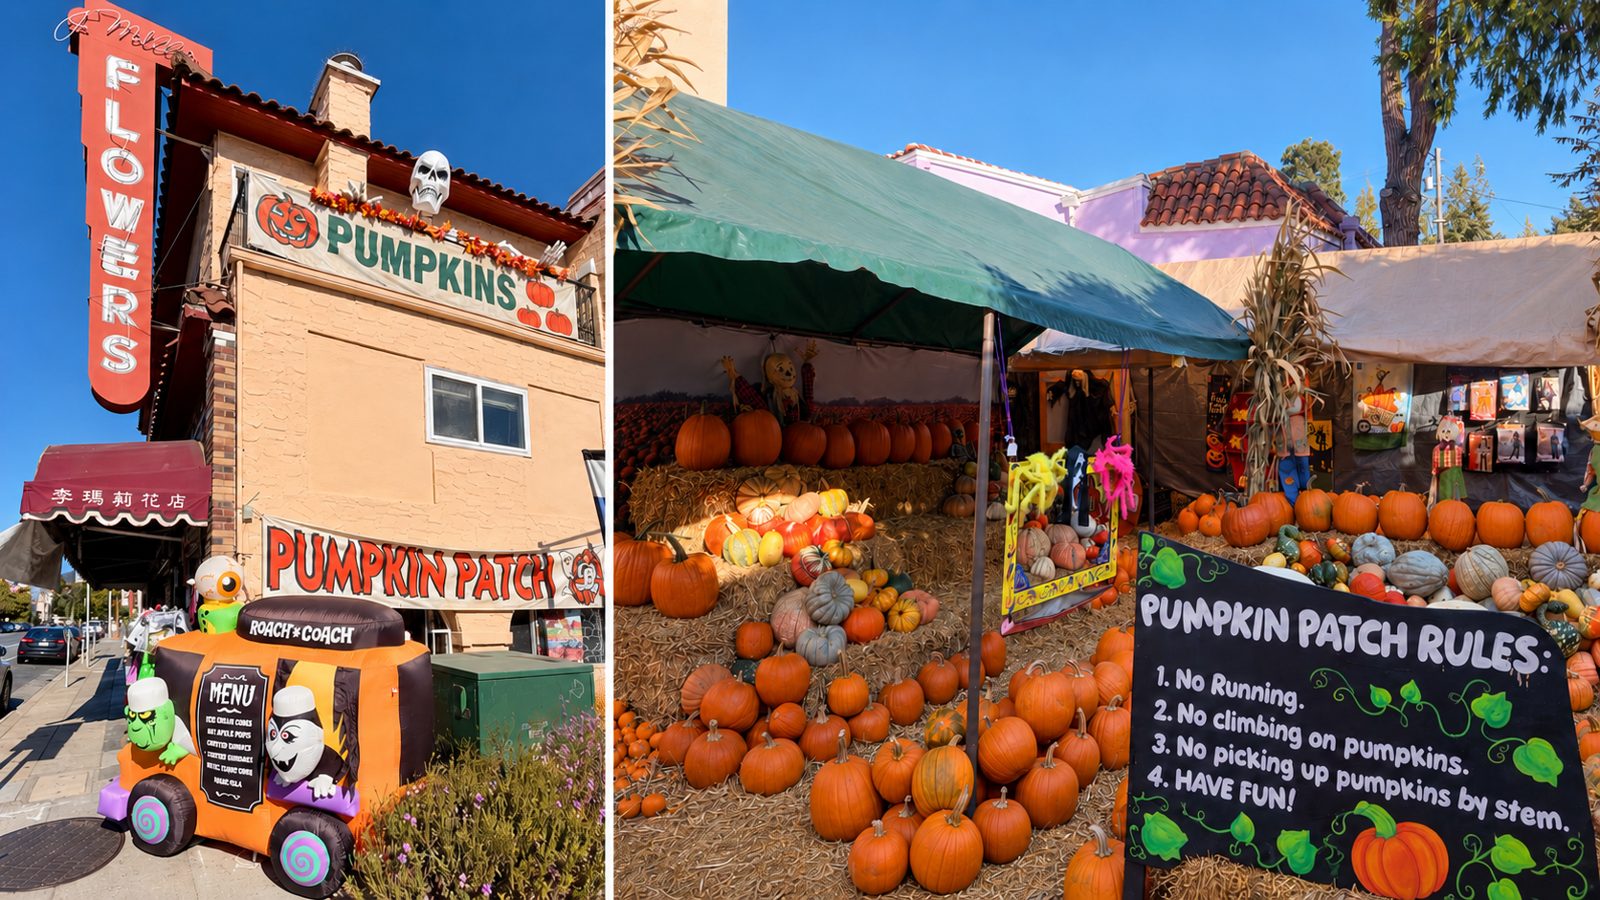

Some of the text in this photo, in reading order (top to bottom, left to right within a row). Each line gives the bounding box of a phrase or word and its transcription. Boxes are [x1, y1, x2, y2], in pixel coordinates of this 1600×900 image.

[101, 54, 145, 374] FLOWERS
[327, 214, 517, 311] PUMPKINS
[51, 488, 187, 508] 李瑪莉花店
[267, 526, 555, 600] PUMPKIN PATCH
[1140, 593, 1552, 675] PUMPKIN PATCH RULES:
[209, 682, 256, 707] MENU
[1157, 665, 1304, 714] 1. No Running.
[1153, 699, 1470, 776] 2. No climbing on pumpkins.
[1146, 765, 1297, 813] 4. HAVE FUN!
[1152, 733, 1570, 832] 3. No picking up pumpkins by stem.
